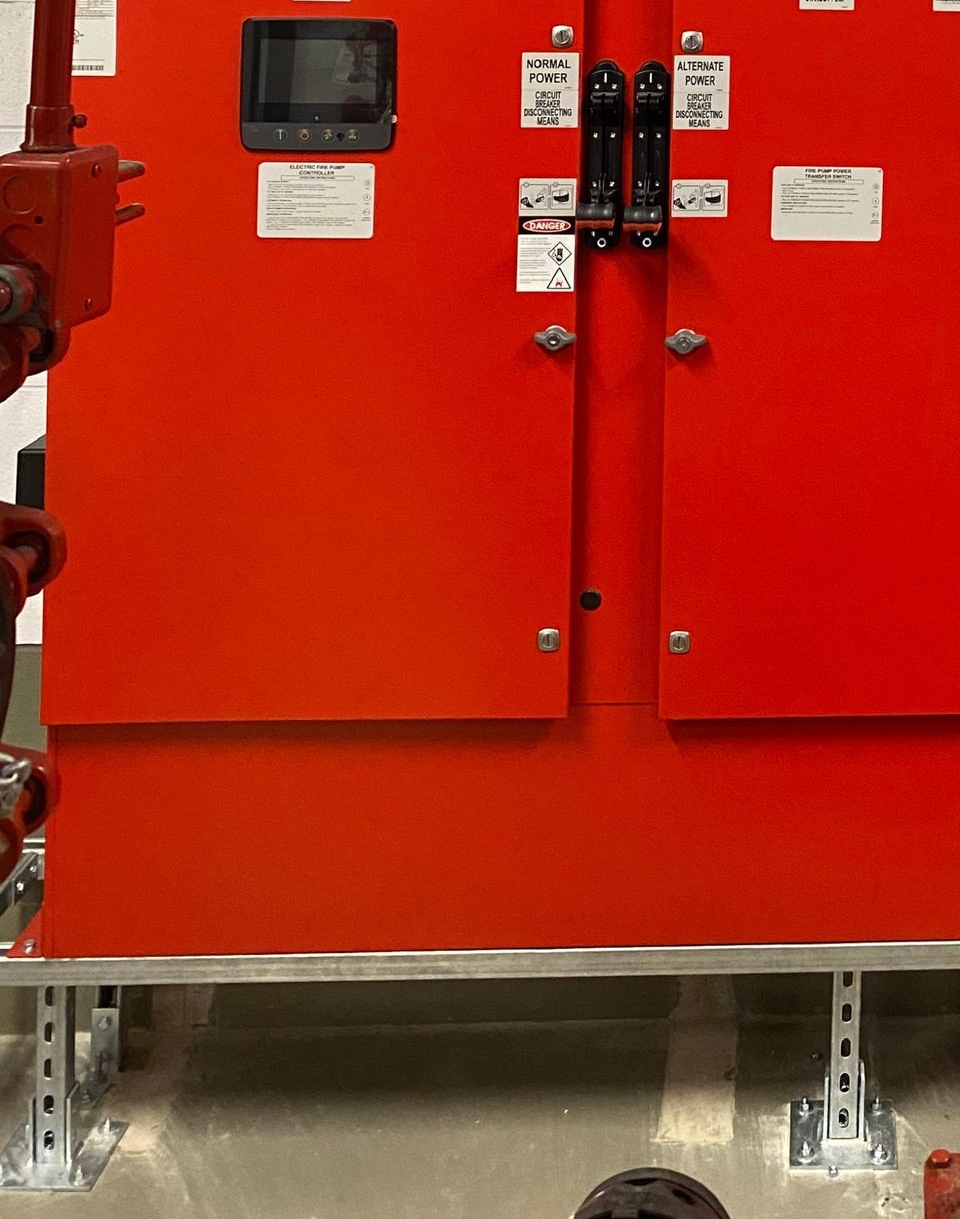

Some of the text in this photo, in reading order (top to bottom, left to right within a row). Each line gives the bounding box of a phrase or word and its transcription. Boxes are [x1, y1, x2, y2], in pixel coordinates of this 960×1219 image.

[526, 59, 571, 68] NORMAL
[677, 62, 724, 71] ALTERNATE
[529, 73, 567, 83] POWER
[685, 76, 715, 86] POWER
[535, 91, 561, 99] CIRCUIT
[535, 100, 560, 108] BREAKER
[687, 102, 711, 110] BREAKER
[676, 111, 723, 119] DISCONNECTING
[537, 117, 559, 125] MEANS
[529, 222, 566, 230] DANGER
